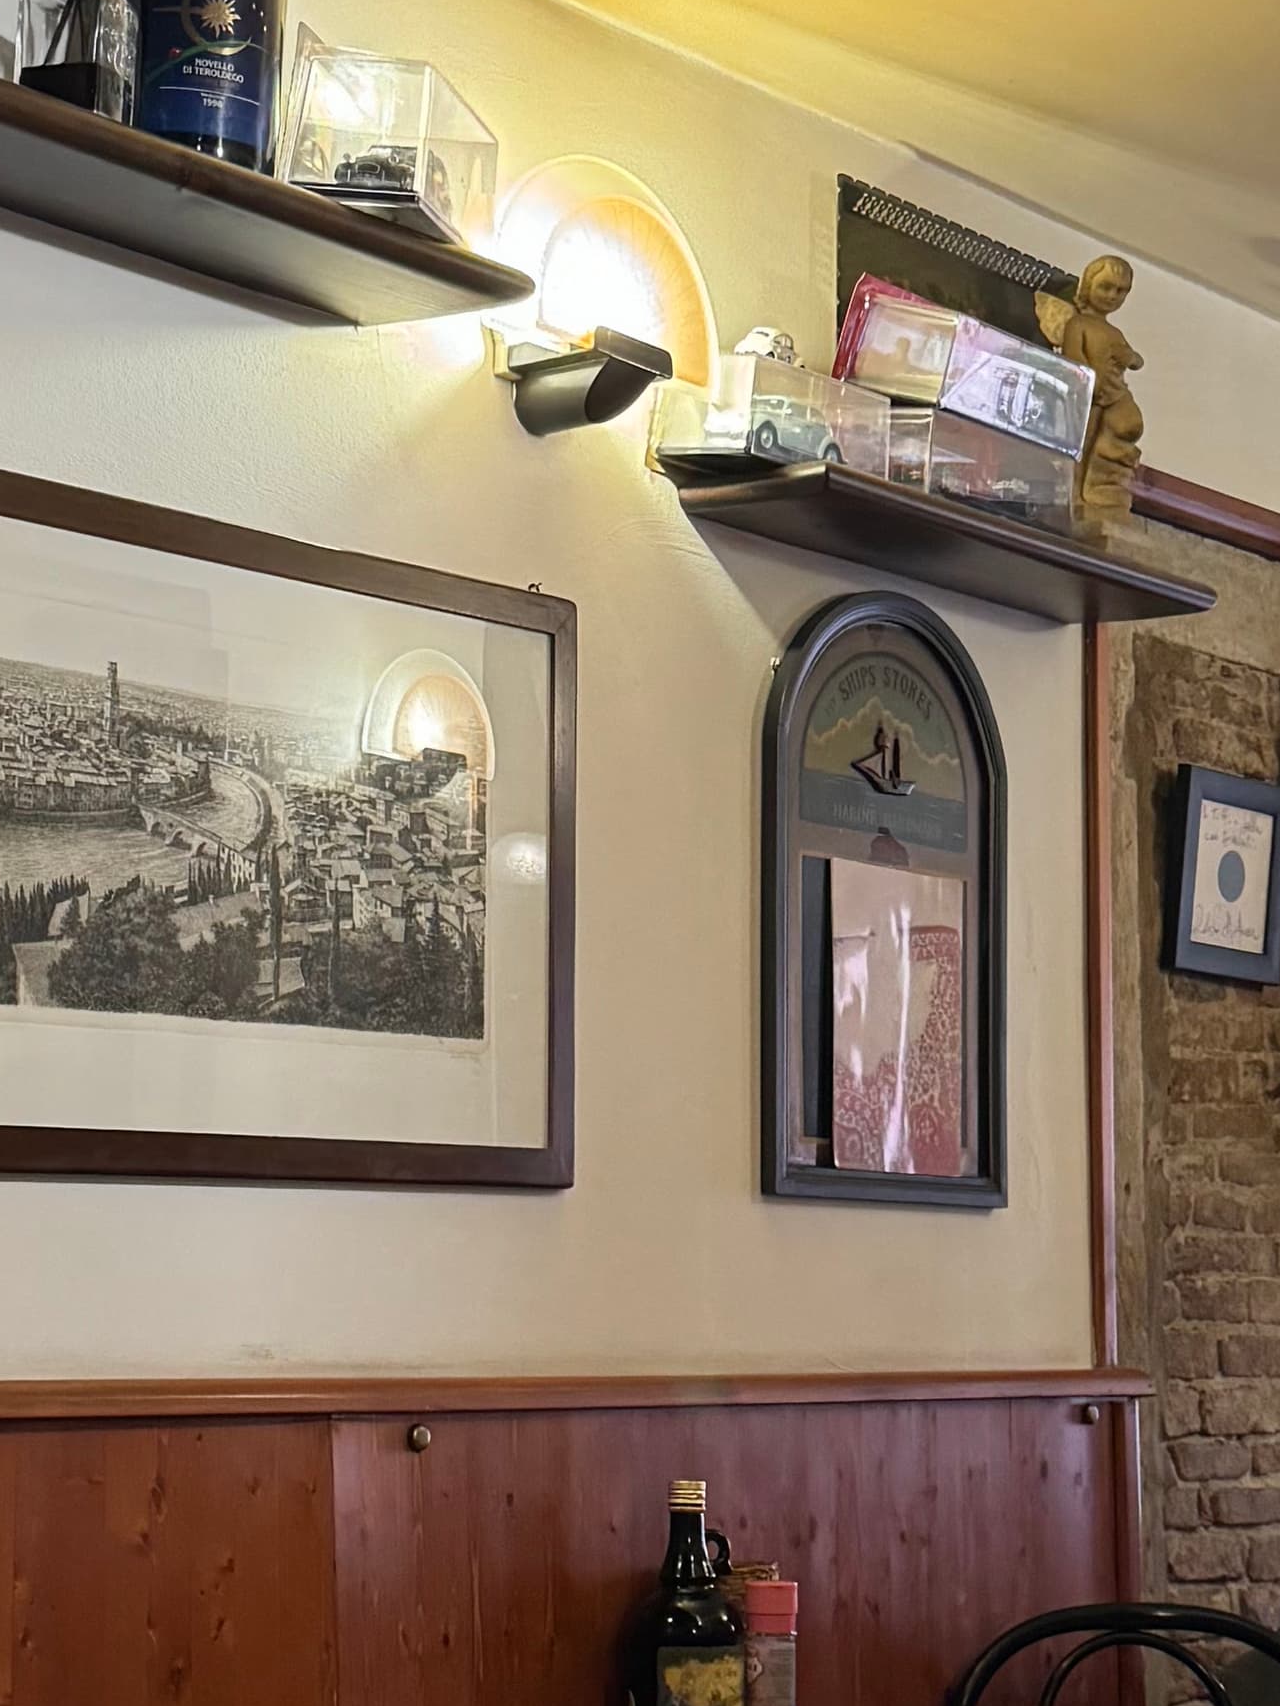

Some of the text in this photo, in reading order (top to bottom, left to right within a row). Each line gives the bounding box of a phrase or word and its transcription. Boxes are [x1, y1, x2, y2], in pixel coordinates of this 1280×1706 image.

[182, 65, 193, 75] DI
[194, 66, 245, 85] TEROLDEGO
[194, 57, 235, 73] NOVELLO
[882, 666, 933, 721] STORES
